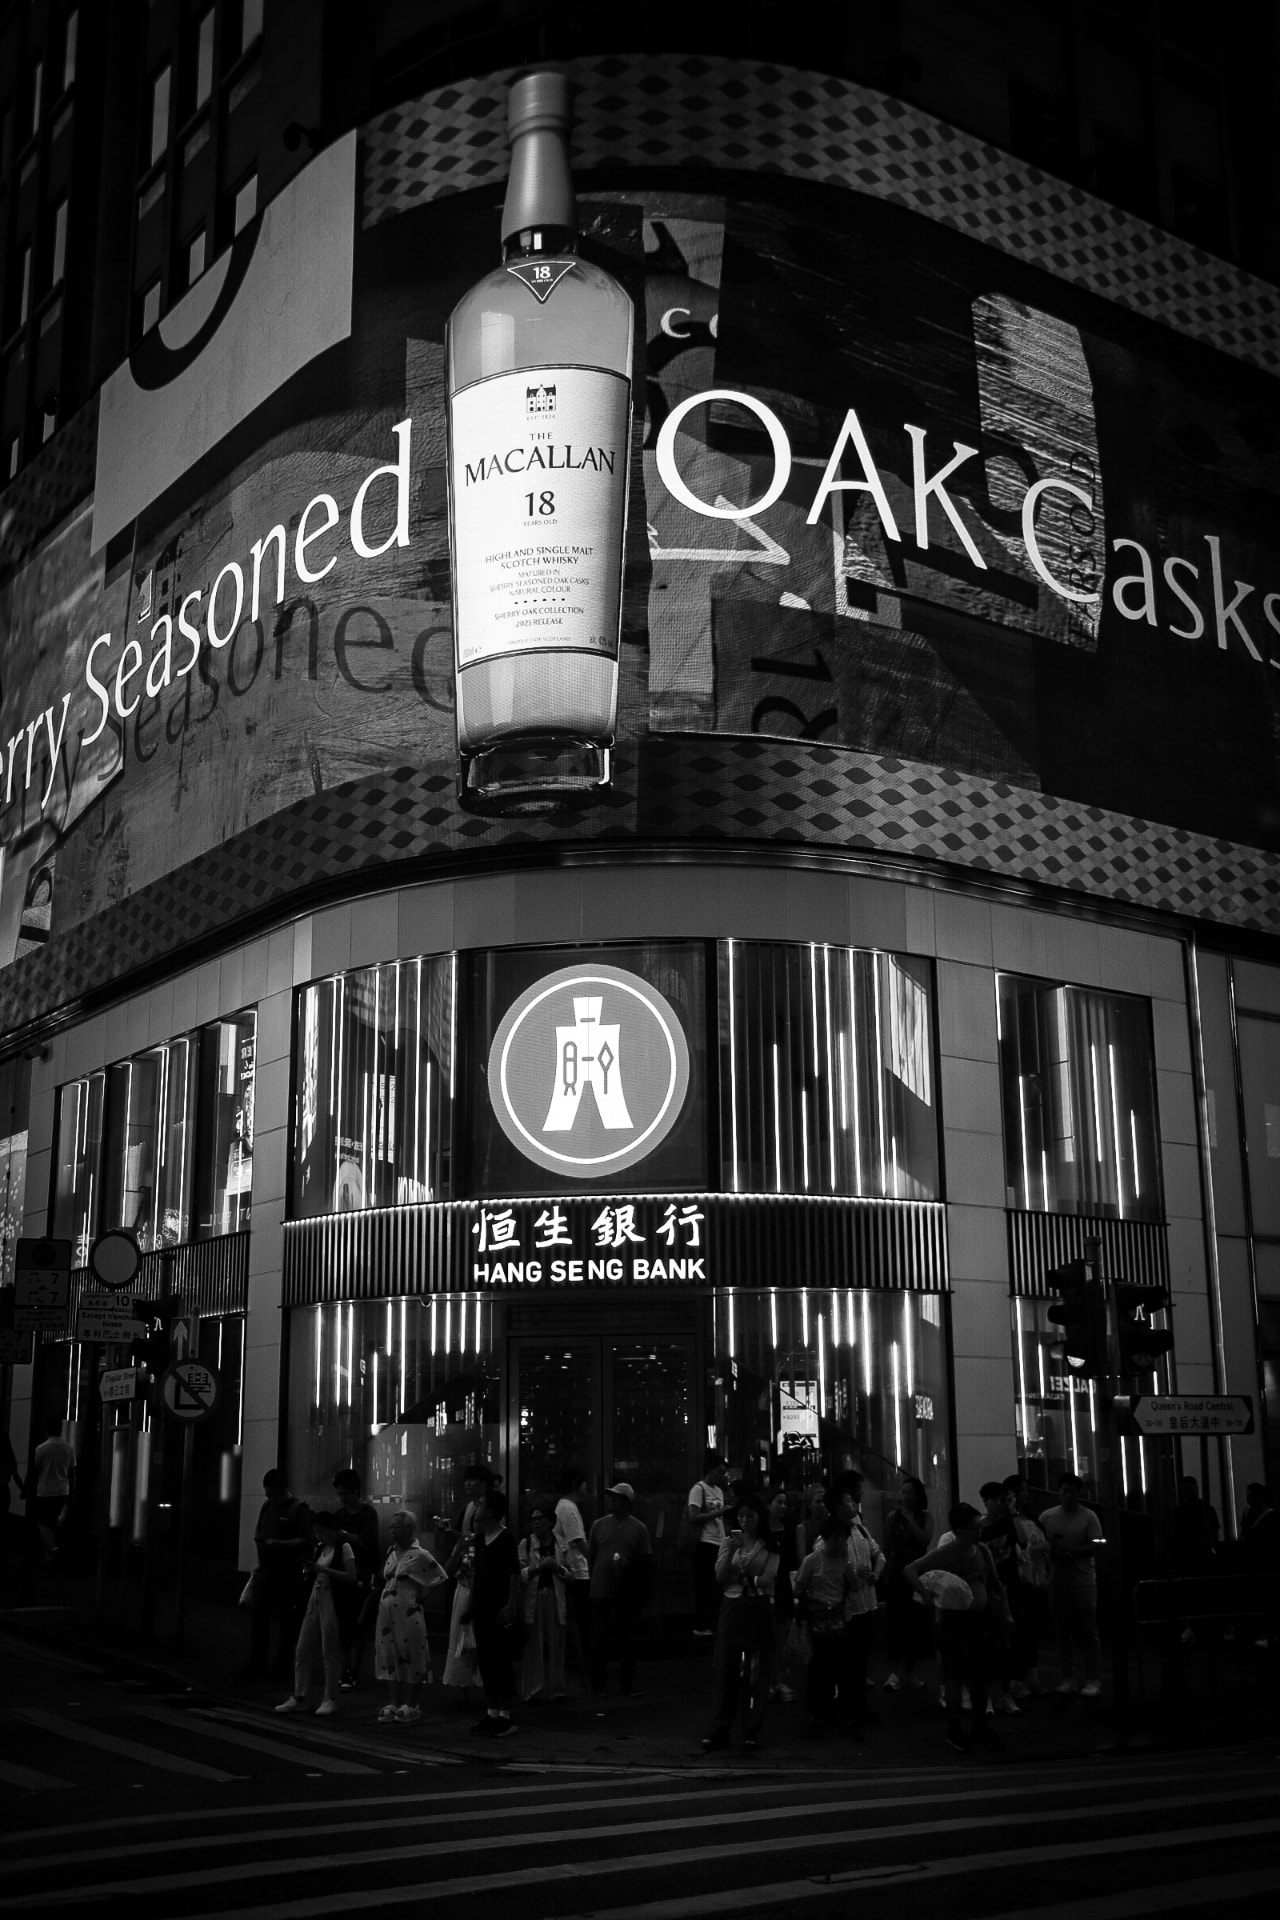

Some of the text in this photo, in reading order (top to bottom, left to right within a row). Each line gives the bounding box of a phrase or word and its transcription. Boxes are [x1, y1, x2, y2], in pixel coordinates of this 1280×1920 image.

[533, 266, 551, 279] 18
[529, 432, 553, 441] THE
[465, 445, 616, 487] MACALLAN
[655, 389, 988, 571] OAK
[525, 490, 555, 517] 18
[485, 545, 595, 564] HIGHLAND SINGLE MALT
[500, 556, 579, 570] SCOTCH WHISKY
[517, 568, 561, 578] MATURED IN
[489, 577, 590, 593] SHERRY SEASONED OAK CASKS
[508, 585, 571, 597] NATURAL COLOUR
[0, 692, 73, 809] rry
[81, 418, 412, 746] Seasoned
[494, 606, 585, 621] SHERRY OAK COLLECTION
[515, 617, 564, 628] 2025 RELEASE
[472, 1203, 705, 1252] 恒生銀行
[473, 1258, 706, 1283] HANG SENG BANK
[51, 1273, 59, 1285] 7
[50, 1291, 58, 1304] 7
[116, 1295, 130, 1307] 10
[82, 1312, 106, 1320] Except
[15, 1349, 29, 1361] 12
[1151, 1400, 1234, 1412] Queen's Road Central
[1169, 1415, 1220, 1430] 皇后大道中
